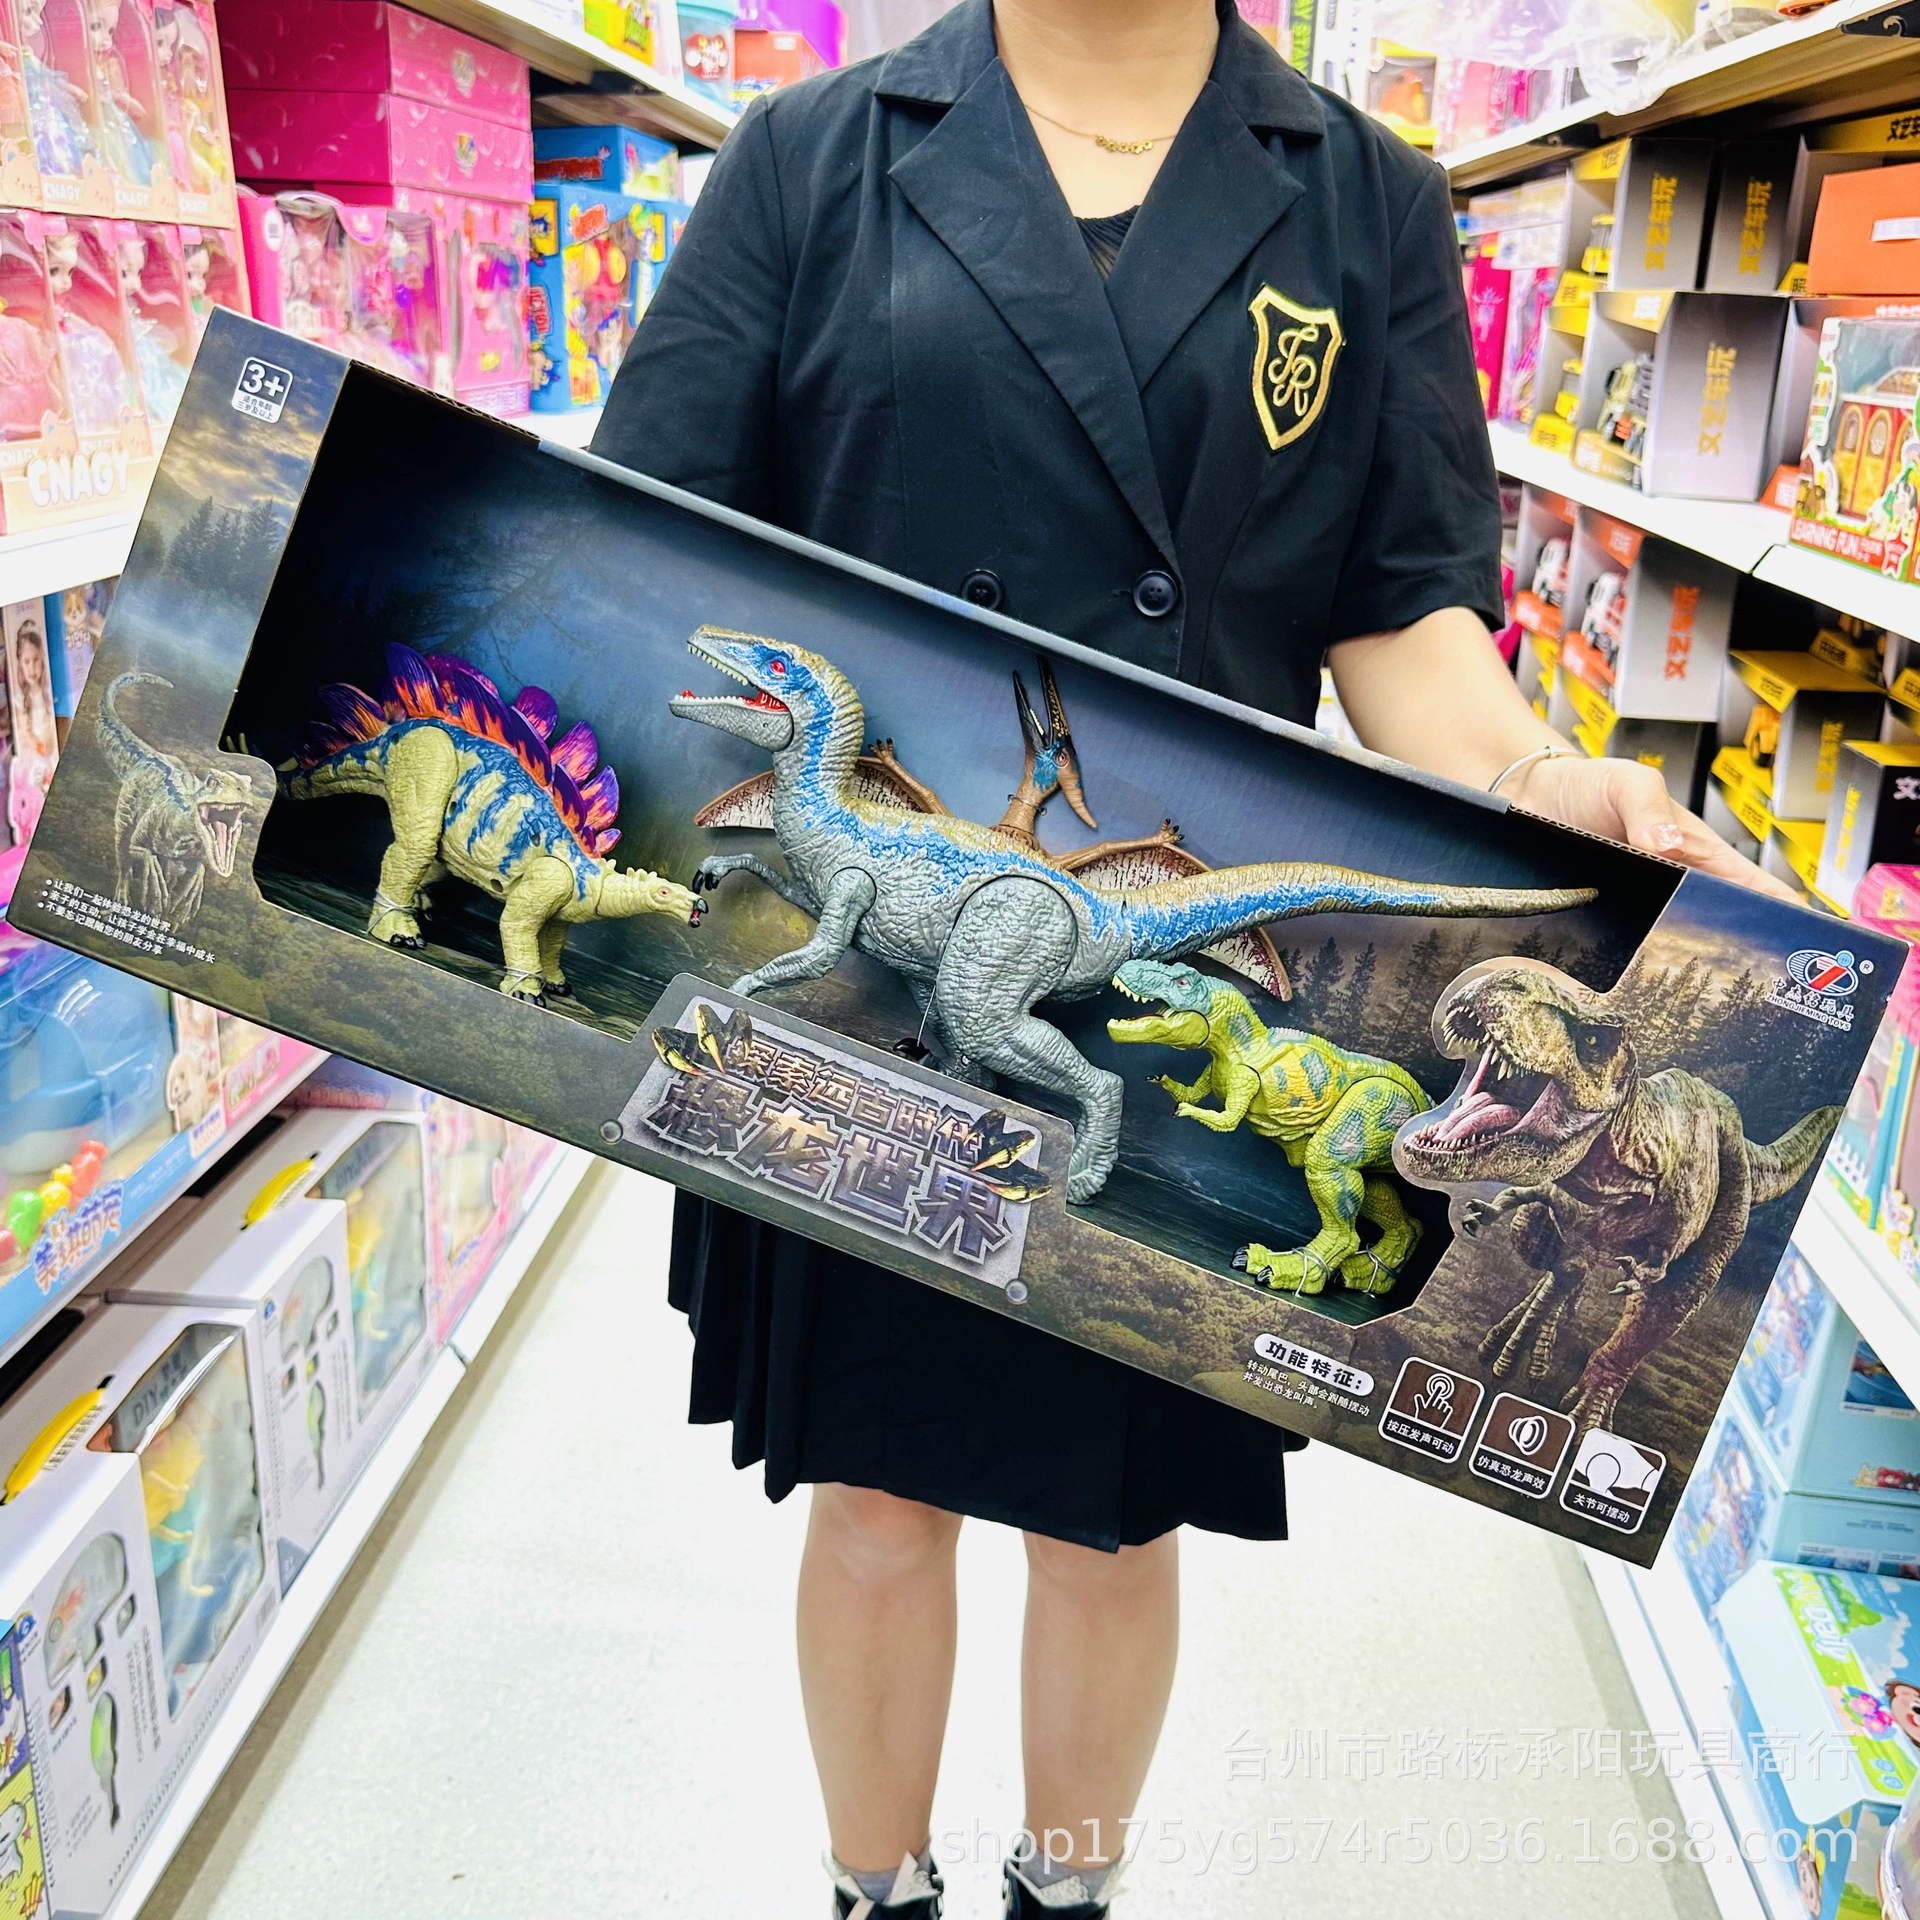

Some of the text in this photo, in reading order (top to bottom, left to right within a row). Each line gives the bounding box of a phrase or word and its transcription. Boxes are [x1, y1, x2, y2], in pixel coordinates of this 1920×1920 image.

[1645, 172, 1678, 271] 文艺车玩
[1738, 178, 1773, 275] 文艺车玩
[243, 363, 284, 397] 3+
[1698, 341, 1747, 456] 文艺车玩
[27, 447, 130, 507] CNAGY
[1765, 992, 1851, 1031] ZHONGJIEMING TOYS
[725, 1034, 984, 1167] 探索远古时代
[640, 1072, 1012, 1264] 恐龙世界
[1386, 1419, 1455, 1455] 按压发声可动
[1476, 1455, 1546, 1491] 仿真恐龙声效
[1573, 1492, 1631, 1524] 关节可摆动
